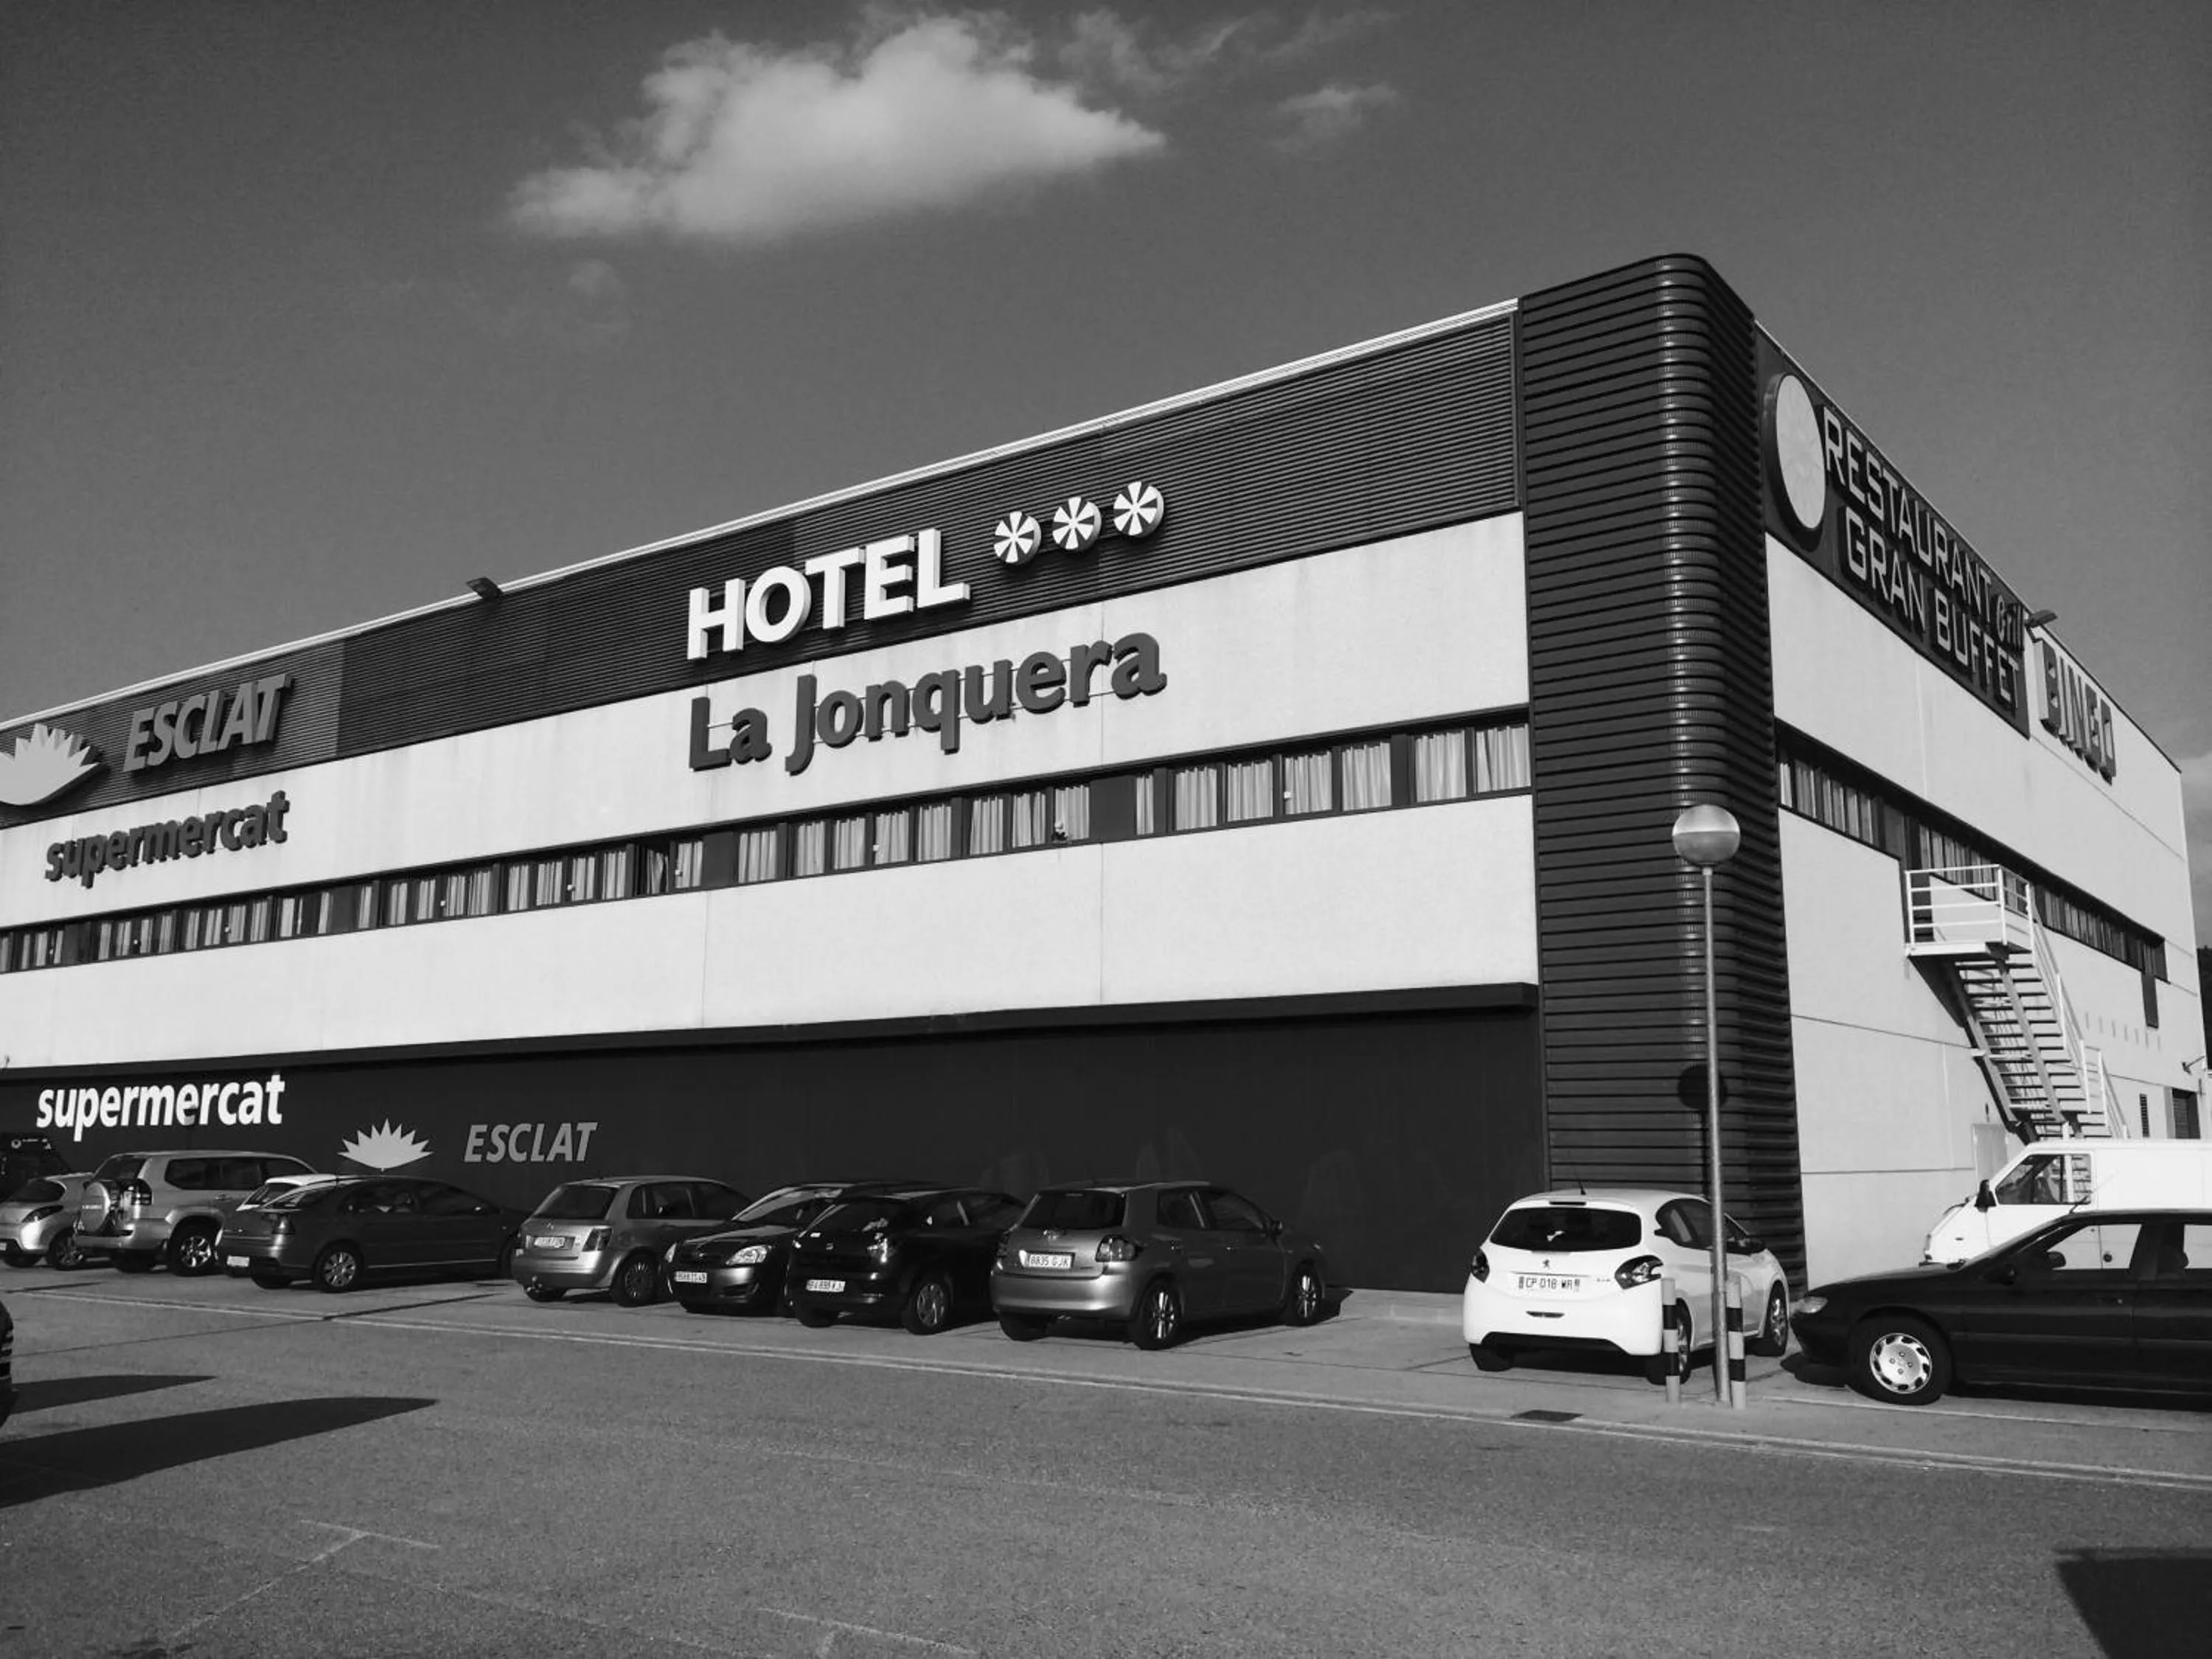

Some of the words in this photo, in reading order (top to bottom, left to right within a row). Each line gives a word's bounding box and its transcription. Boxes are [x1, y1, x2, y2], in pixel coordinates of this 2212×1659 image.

[1823, 406, 1992, 625] RESTAURANT
[687, 528, 970, 659] HOTEL
[1846, 506, 1927, 634] GRAN
[1935, 587, 2020, 709] BUFFET
[123, 672, 293, 772] ESCLAT
[689, 697, 772, 771] La
[785, 632, 1166, 775] Jonquera
[45, 790, 290, 887] supermercat
[36, 1072, 285, 1141] supermercat
[464, 1121, 598, 1163] ESCLAT
